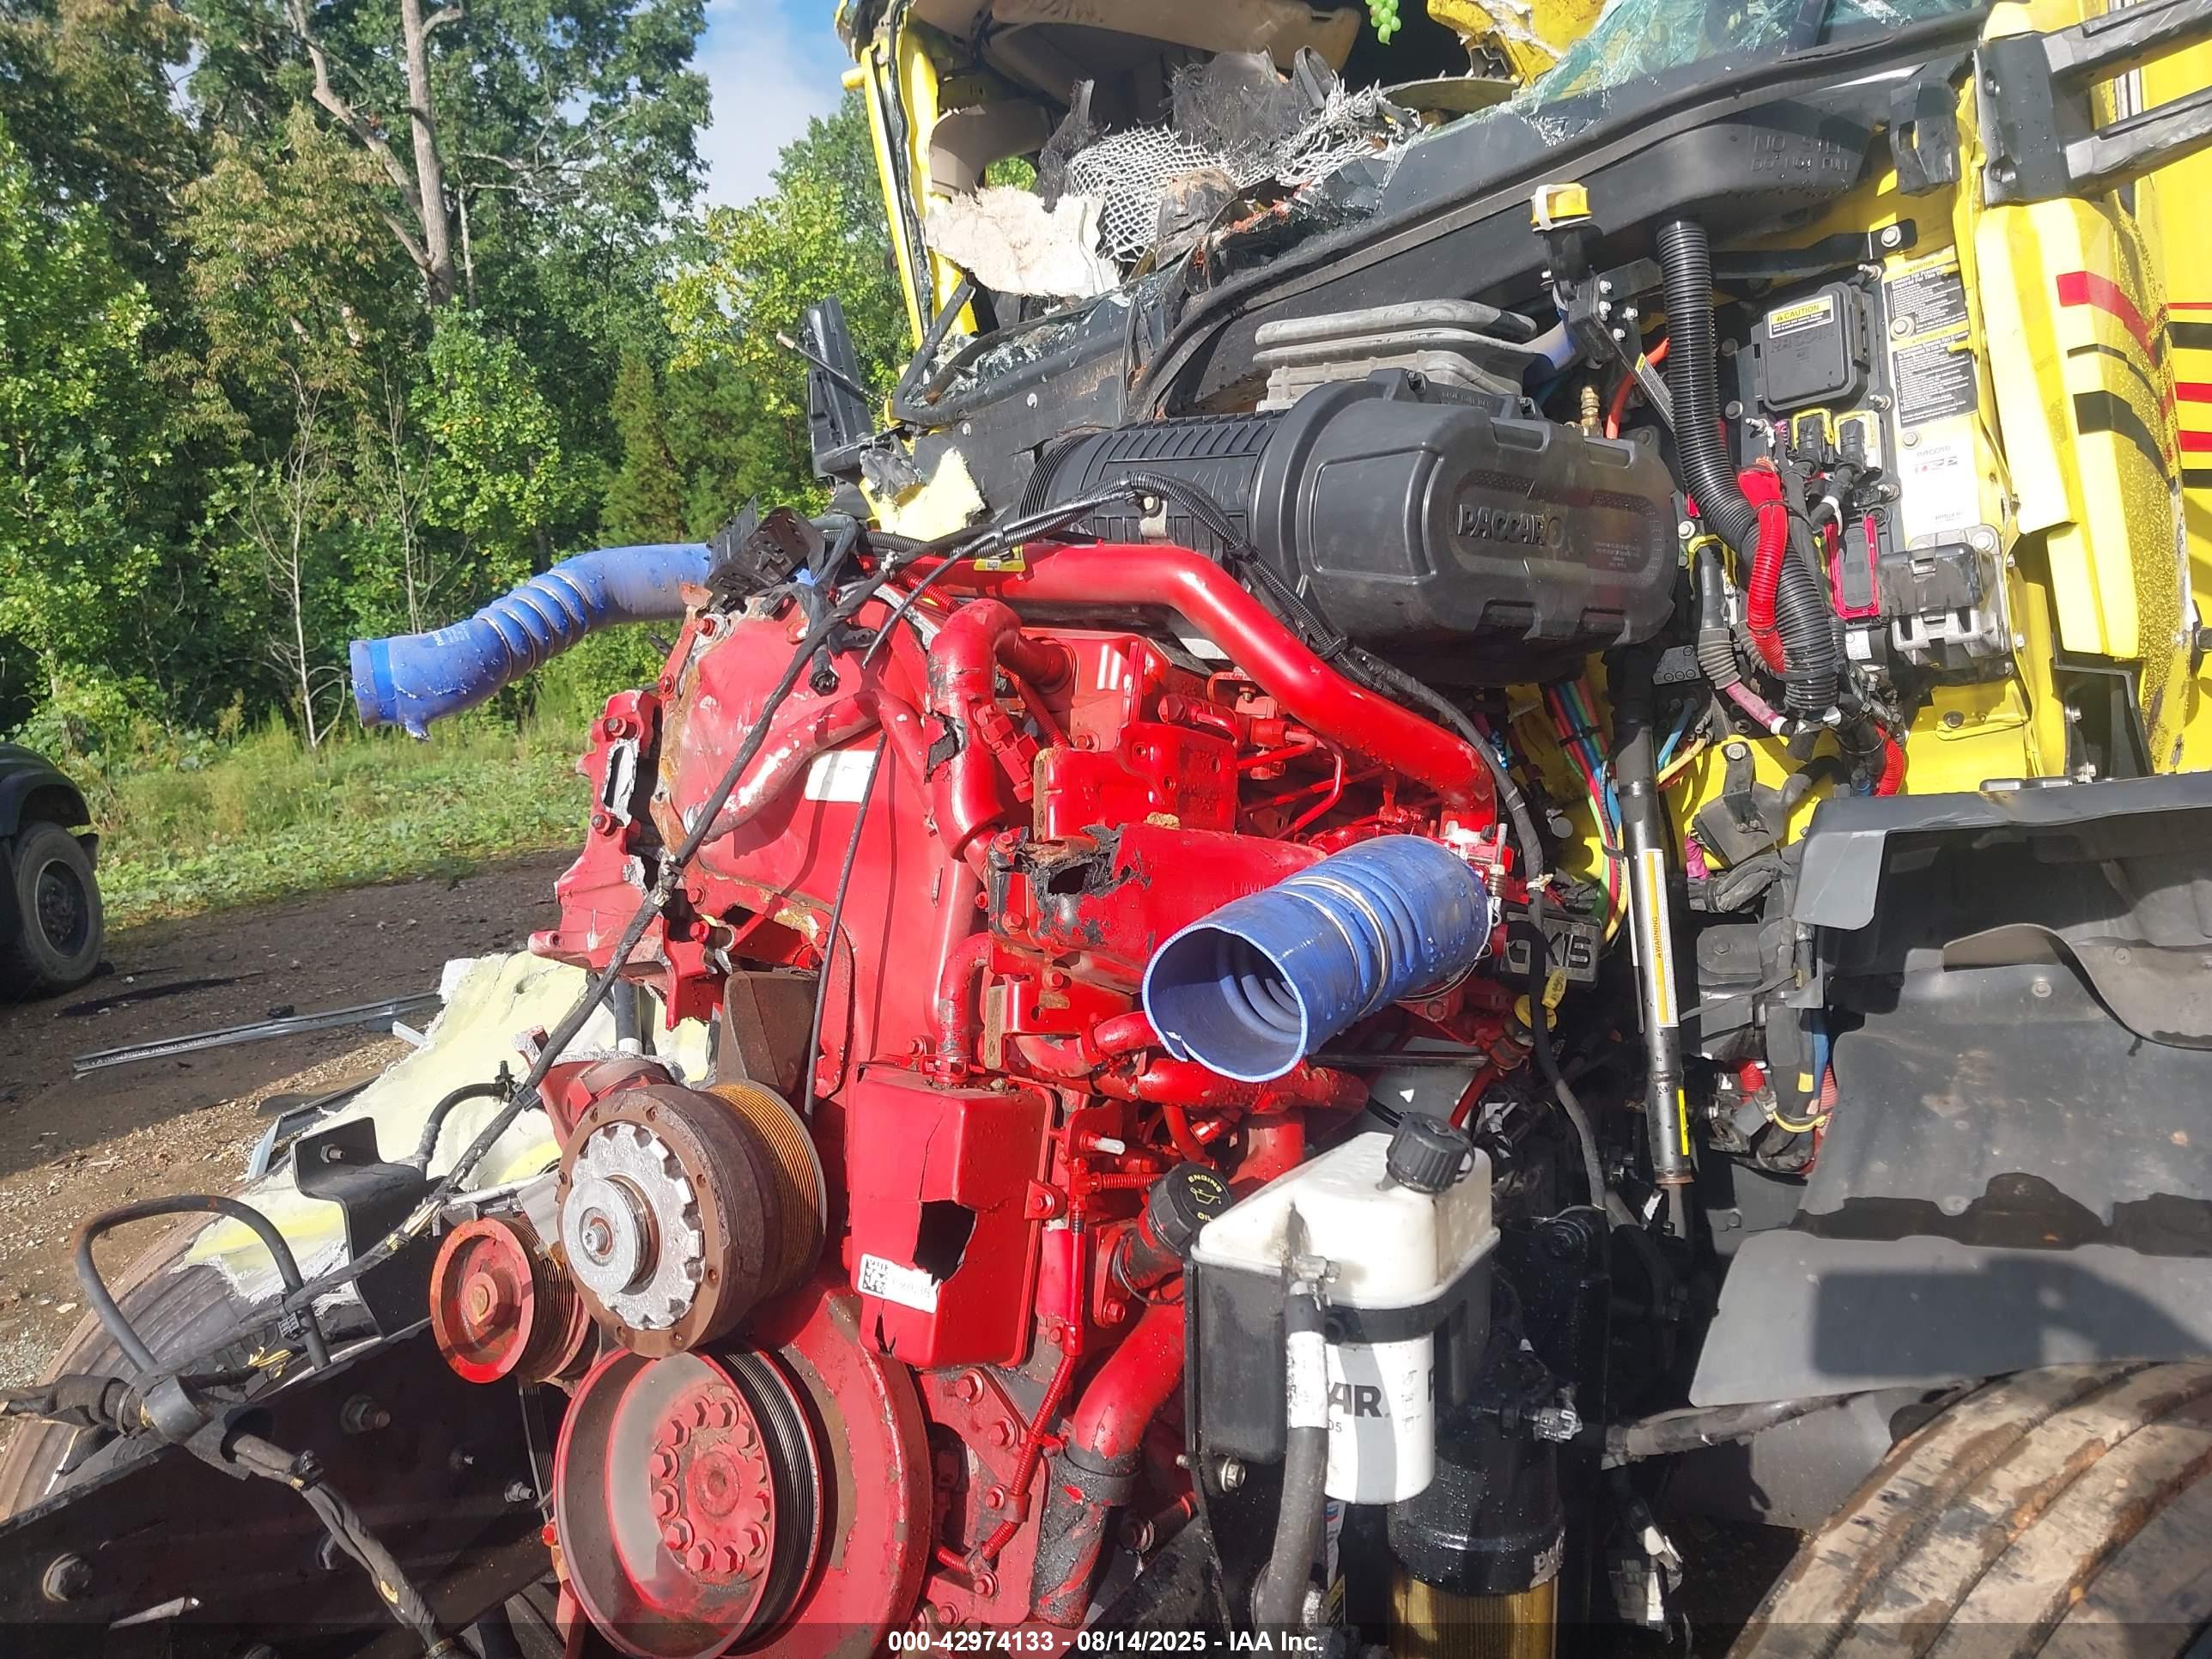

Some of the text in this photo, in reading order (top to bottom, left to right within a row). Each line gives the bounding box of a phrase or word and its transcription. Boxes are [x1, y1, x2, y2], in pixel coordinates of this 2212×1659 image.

[1784, 304, 1820, 319] CAUTION
[1457, 503, 1545, 546] PACCAR
[1652, 916, 1662, 953] WARNING
[1188, 1174, 1223, 1194] ENGINE
[1197, 1212, 1213, 1222] OIL
